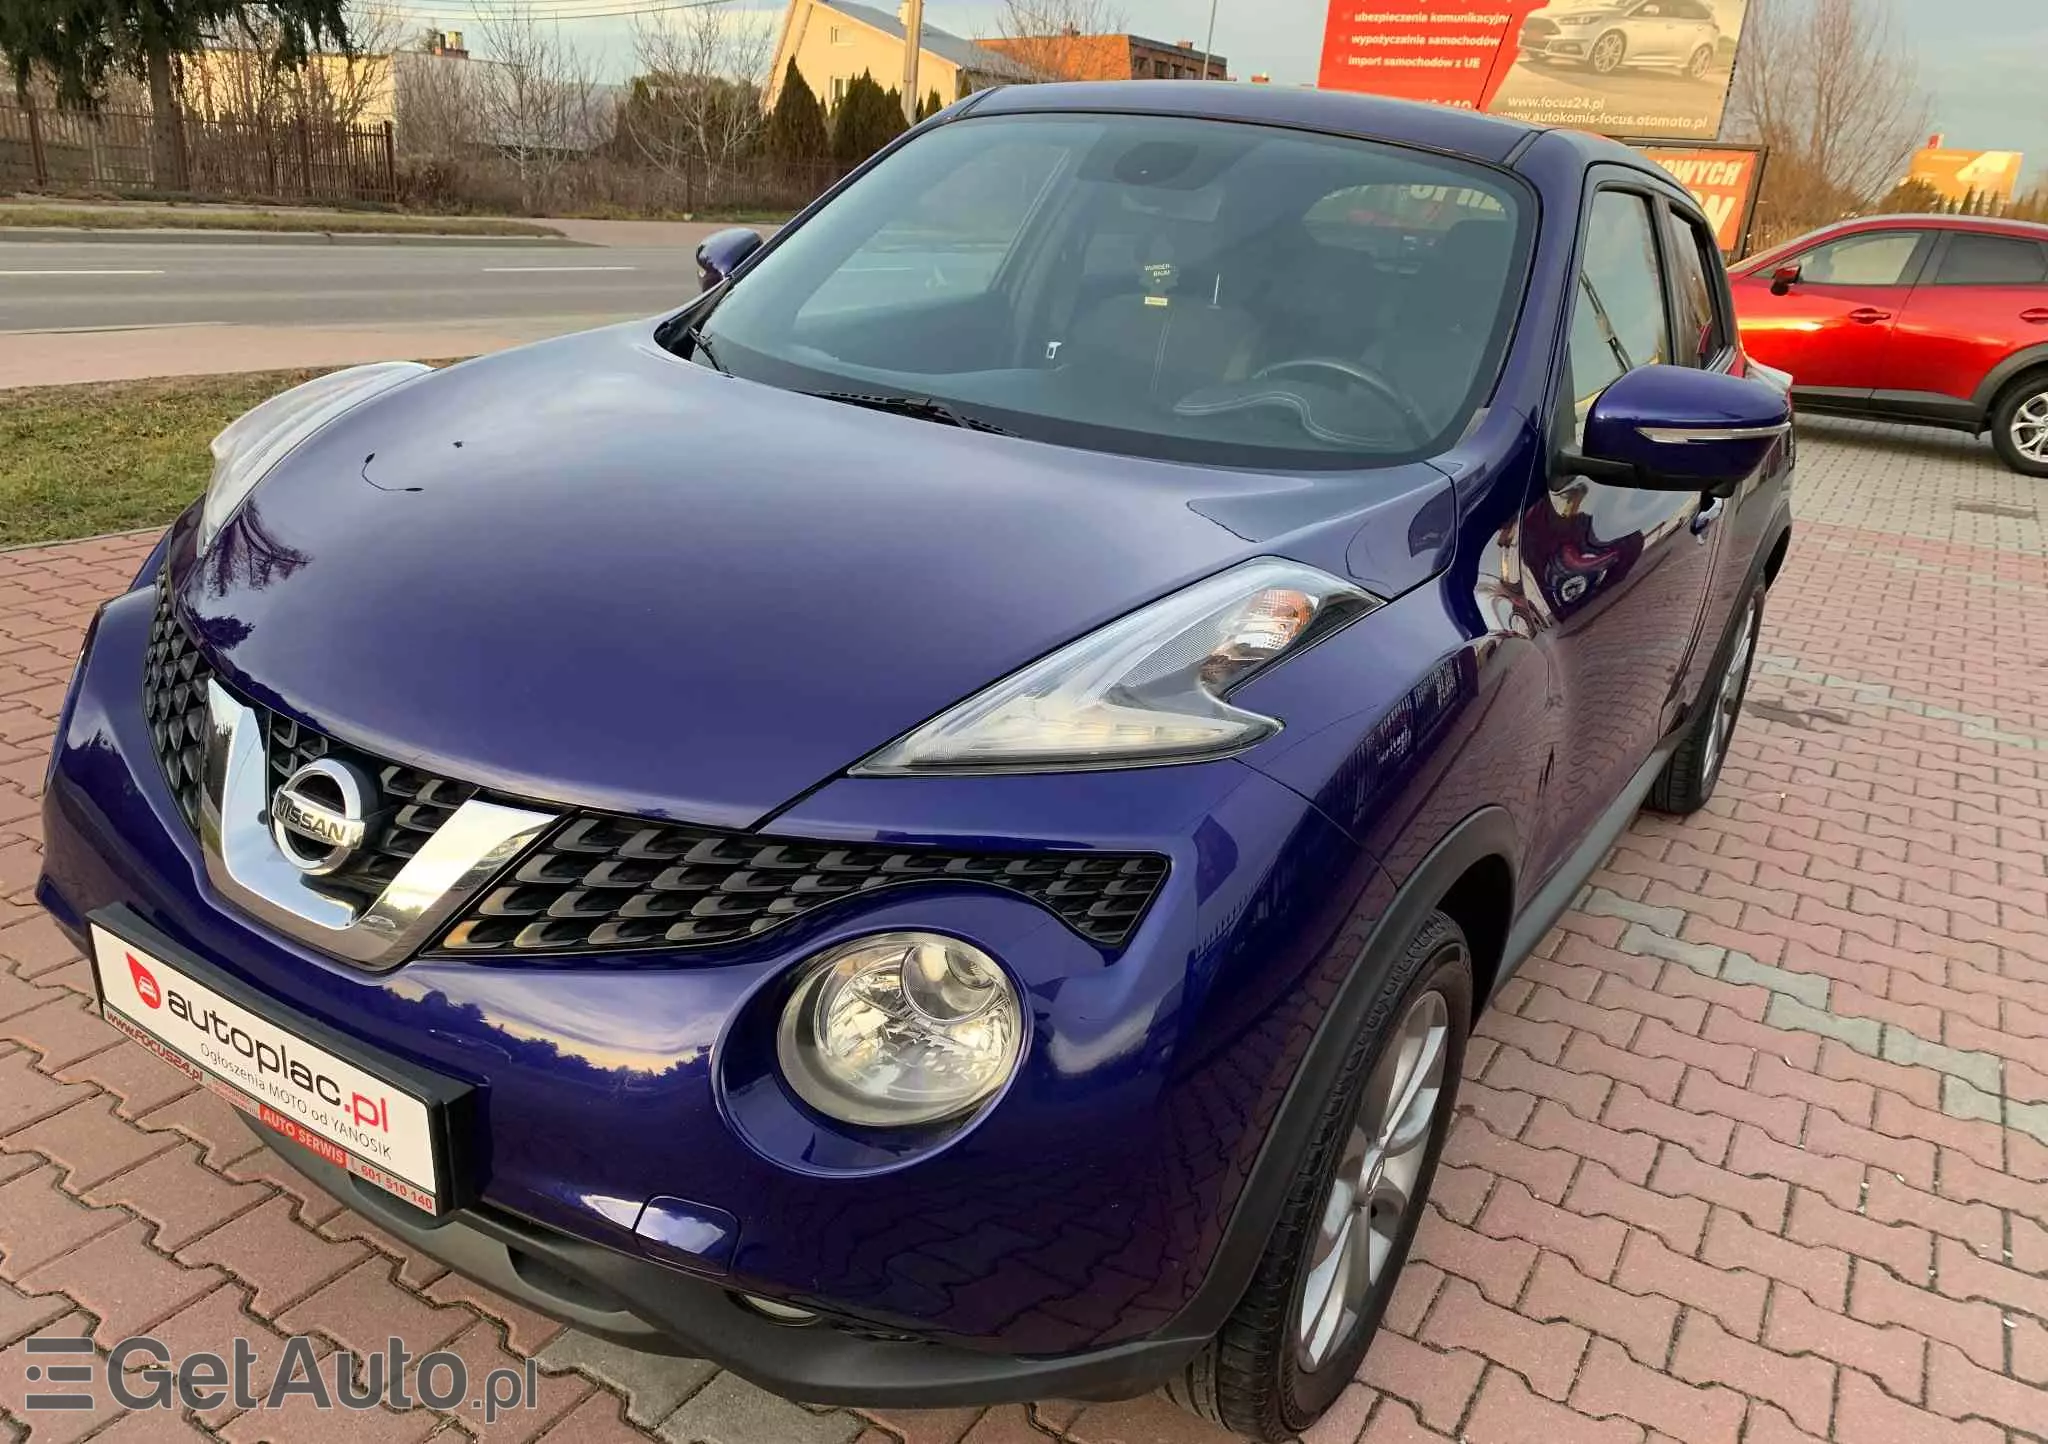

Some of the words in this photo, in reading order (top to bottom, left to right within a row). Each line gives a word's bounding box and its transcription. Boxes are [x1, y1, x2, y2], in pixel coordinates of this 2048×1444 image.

[1348, 55, 1381, 67] import
[1384, 56, 1452, 68] samochodów
[1464, 58, 1481, 68] UE
[1508, 96, 1605, 111] www.focus24.pl
[275, 796, 346, 843] NISSAN
[167, 990, 389, 1133] autoplac.pl
[200, 1042, 265, 1090] Ogłoszenia
[269, 1082, 308, 1114] MOTO
[311, 1109, 328, 1126] od
[332, 1118, 393, 1160] YANOSIK
[263, 1109, 296, 1137] AUTO
[298, 1129, 345, 1165] SERWIS
[360, 1165, 382, 1183] 601
[384, 1177, 407, 1196] 510
[411, 1190, 433, 1210] 140
